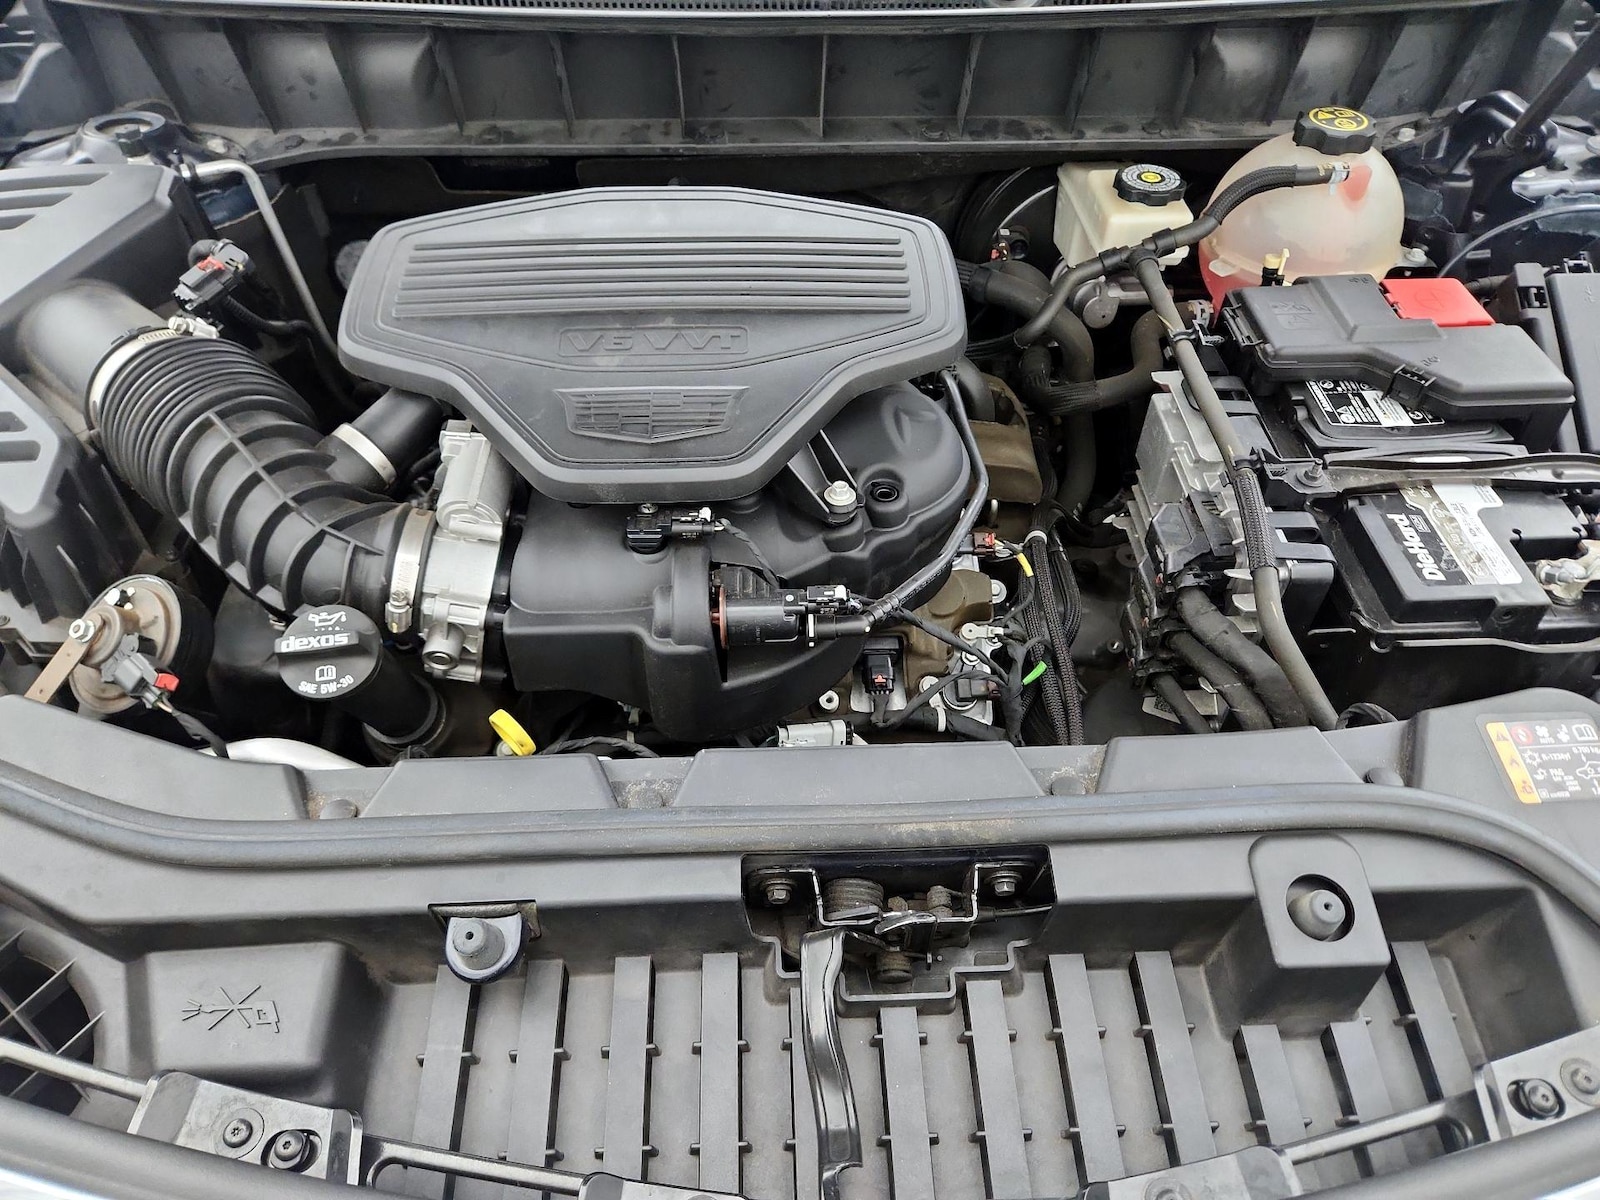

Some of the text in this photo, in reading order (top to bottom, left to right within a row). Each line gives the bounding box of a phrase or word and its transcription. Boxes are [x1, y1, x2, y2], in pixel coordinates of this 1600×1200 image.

[566, 332, 742, 351] V6 VVT
[1386, 512, 1447, 581] DieHard
[281, 633, 351, 652] dexos
[299, 674, 354, 694] SAE 5W-30
